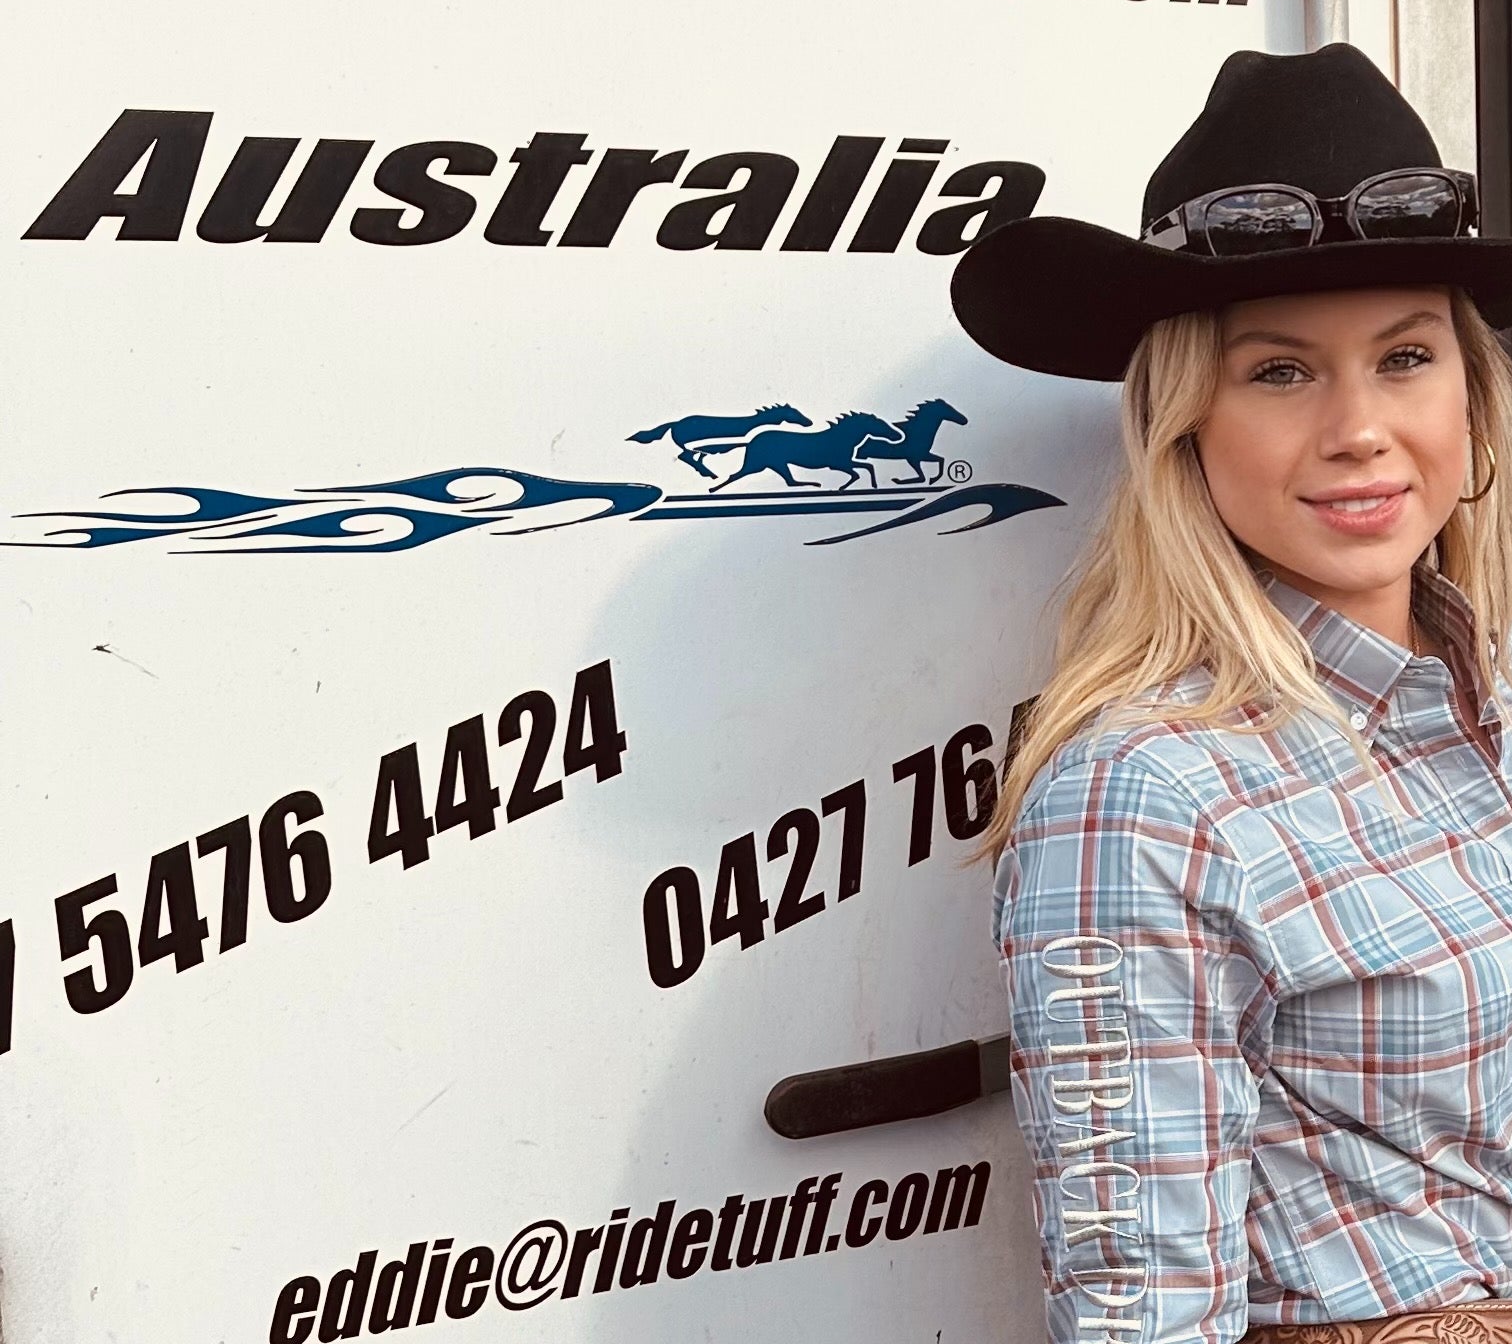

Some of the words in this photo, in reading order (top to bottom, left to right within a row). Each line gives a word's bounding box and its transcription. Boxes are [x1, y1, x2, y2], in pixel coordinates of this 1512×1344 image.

[21, 108, 1047, 256] Australia
[54, 790, 332, 1015] 5476
[367, 658, 627, 871] 4424
[642, 778, 867, 989] 0427
[1041, 935, 1144, 1252] OUTBACK
